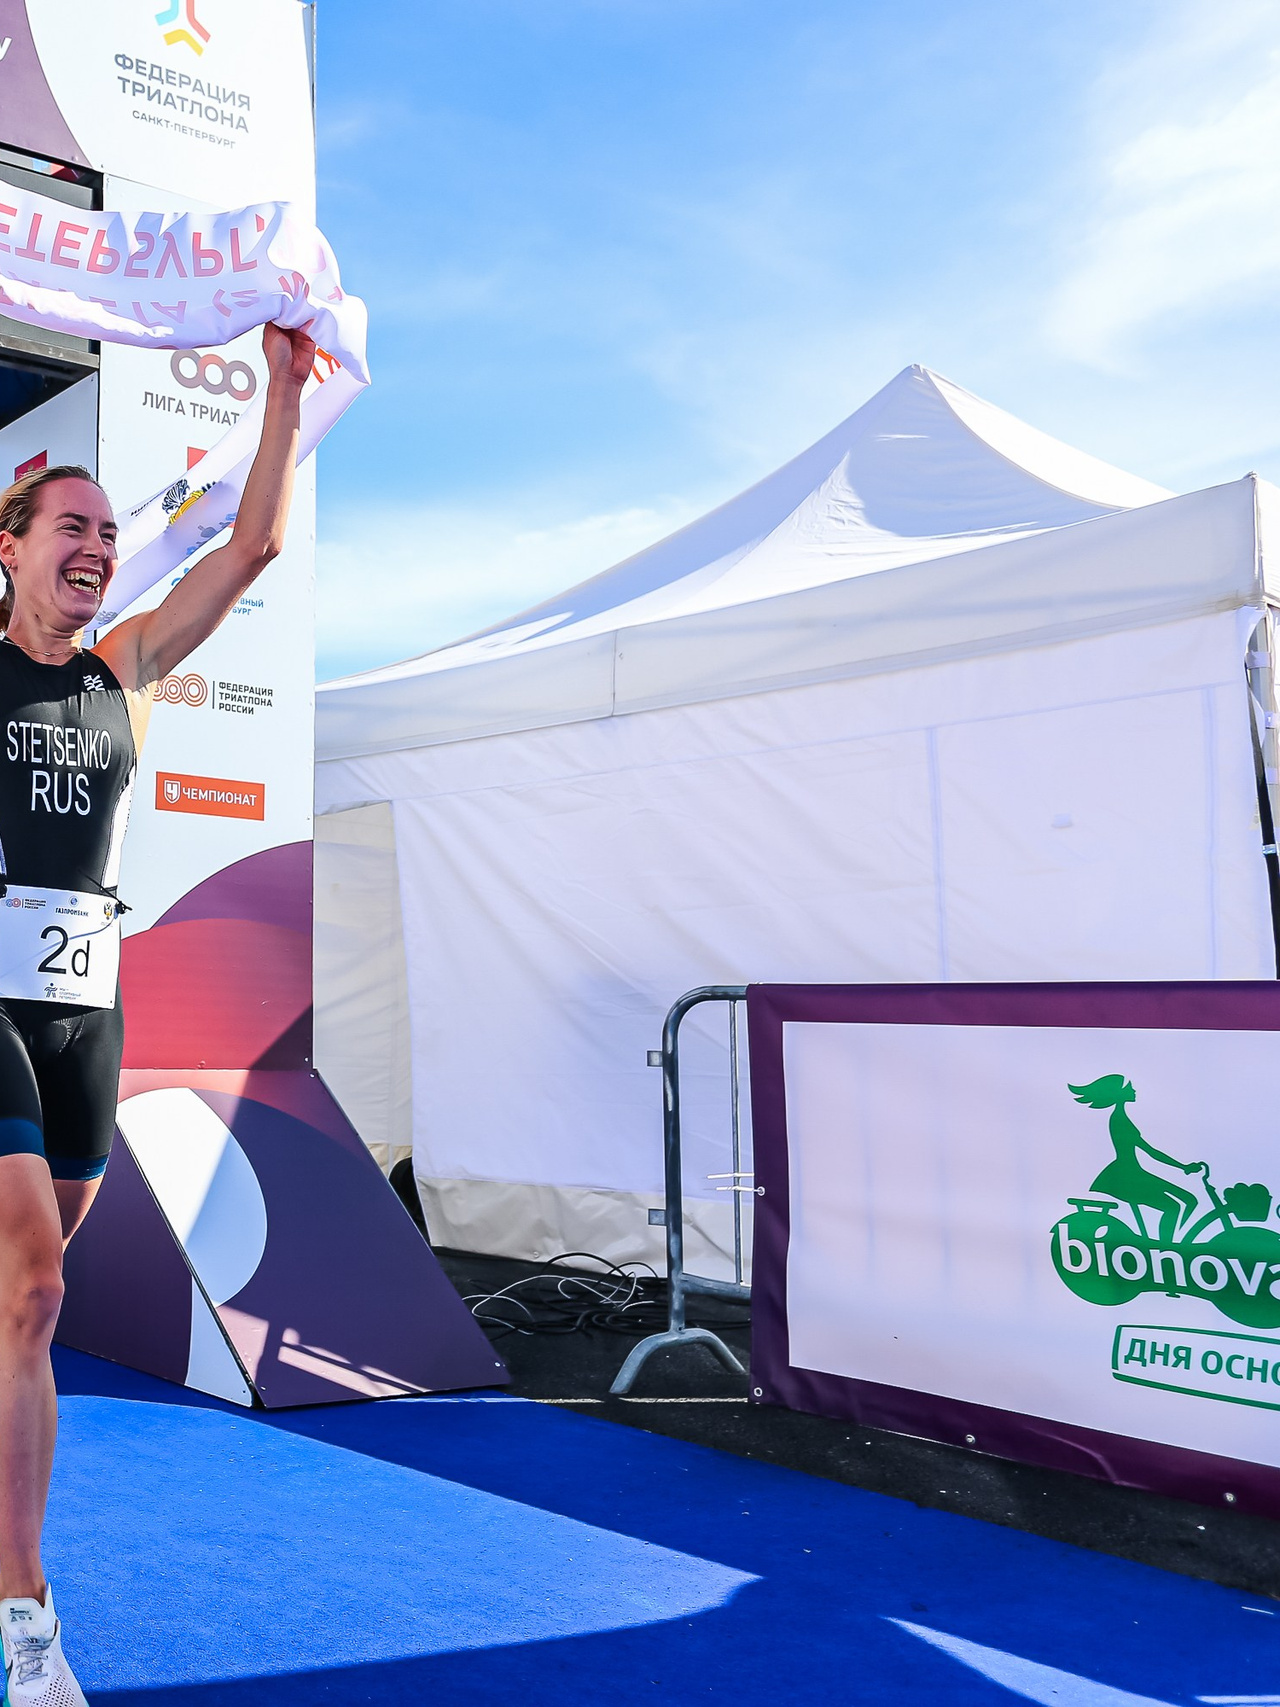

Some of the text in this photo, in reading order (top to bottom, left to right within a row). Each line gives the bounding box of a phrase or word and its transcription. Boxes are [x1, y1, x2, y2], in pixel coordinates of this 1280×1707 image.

[114, 53, 251, 111] ФЕДЕРАЦИЯ
[117, 75, 249, 133] ТРИАТЛОНА
[132, 110, 236, 149] САНКТ-ПЕТЕРБУРГ
[142, 391, 241, 426] ЛИГА ТРИАТ
[238, 597, 264, 608] ВНЫЙ
[218, 681, 273, 697] ФЕДЕРАЦИЯ
[218, 692, 273, 707] ТРИАТЛОНА
[218, 702, 254, 715] РОССИИ
[6, 720, 112, 770] STETSENKO
[30, 769, 91, 816] RUS
[182, 787, 257, 807] ЧЕМПИОНАТ
[1123, 1337, 1192, 1370] ДНЯ
